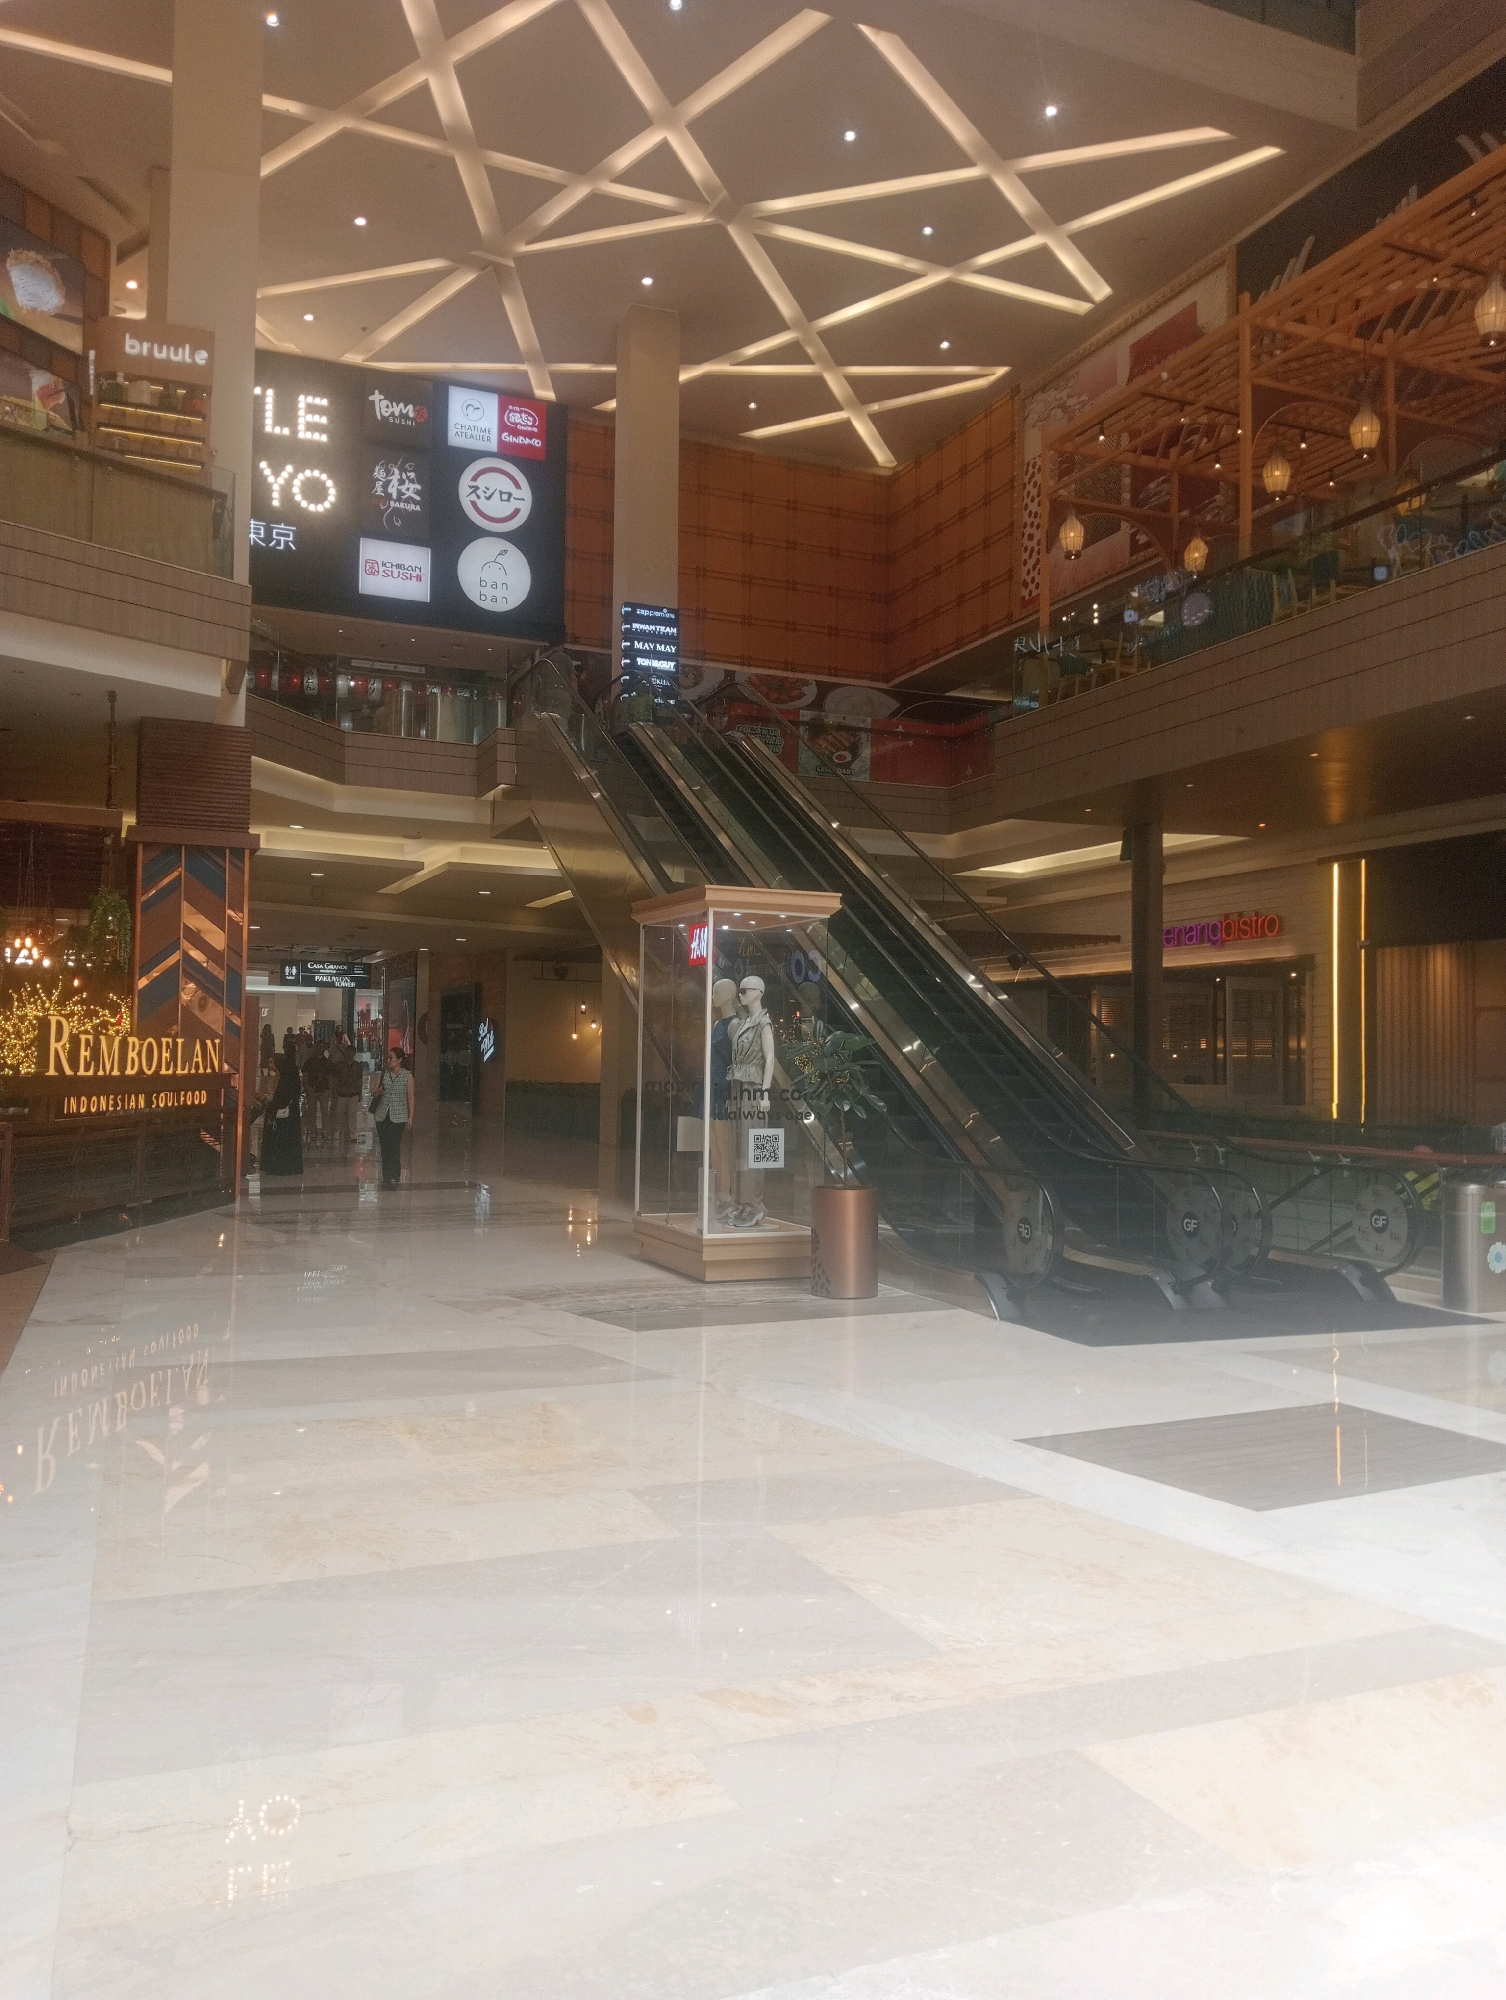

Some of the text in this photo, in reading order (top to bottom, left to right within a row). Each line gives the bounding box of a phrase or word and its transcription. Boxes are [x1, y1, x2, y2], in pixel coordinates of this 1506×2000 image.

[125, 333, 208, 365] bruule
[389, 417, 415, 426] SUSHI
[454, 423, 492, 435] CHATIME
[454, 431, 492, 443] ATEALIER
[502, 432, 541, 447] GINDACO
[466, 484, 526, 502] スシロー
[389, 500, 421, 511] SAKURA
[381, 561, 422, 573] ICHIBAN
[381, 569, 422, 582] SUSHI
[480, 577, 508, 590] ban
[480, 591, 508, 604] ban
[656, 625, 677, 634] TEAM
[634, 641, 676, 653] MAY MAY
[45, 1015, 221, 1077] REMBOELAN
[64, 1090, 207, 1114] INDONESIAN SOULFOOD
[1183, 1218, 1198, 1232] GF
[1371, 1215, 1387, 1228] GF
